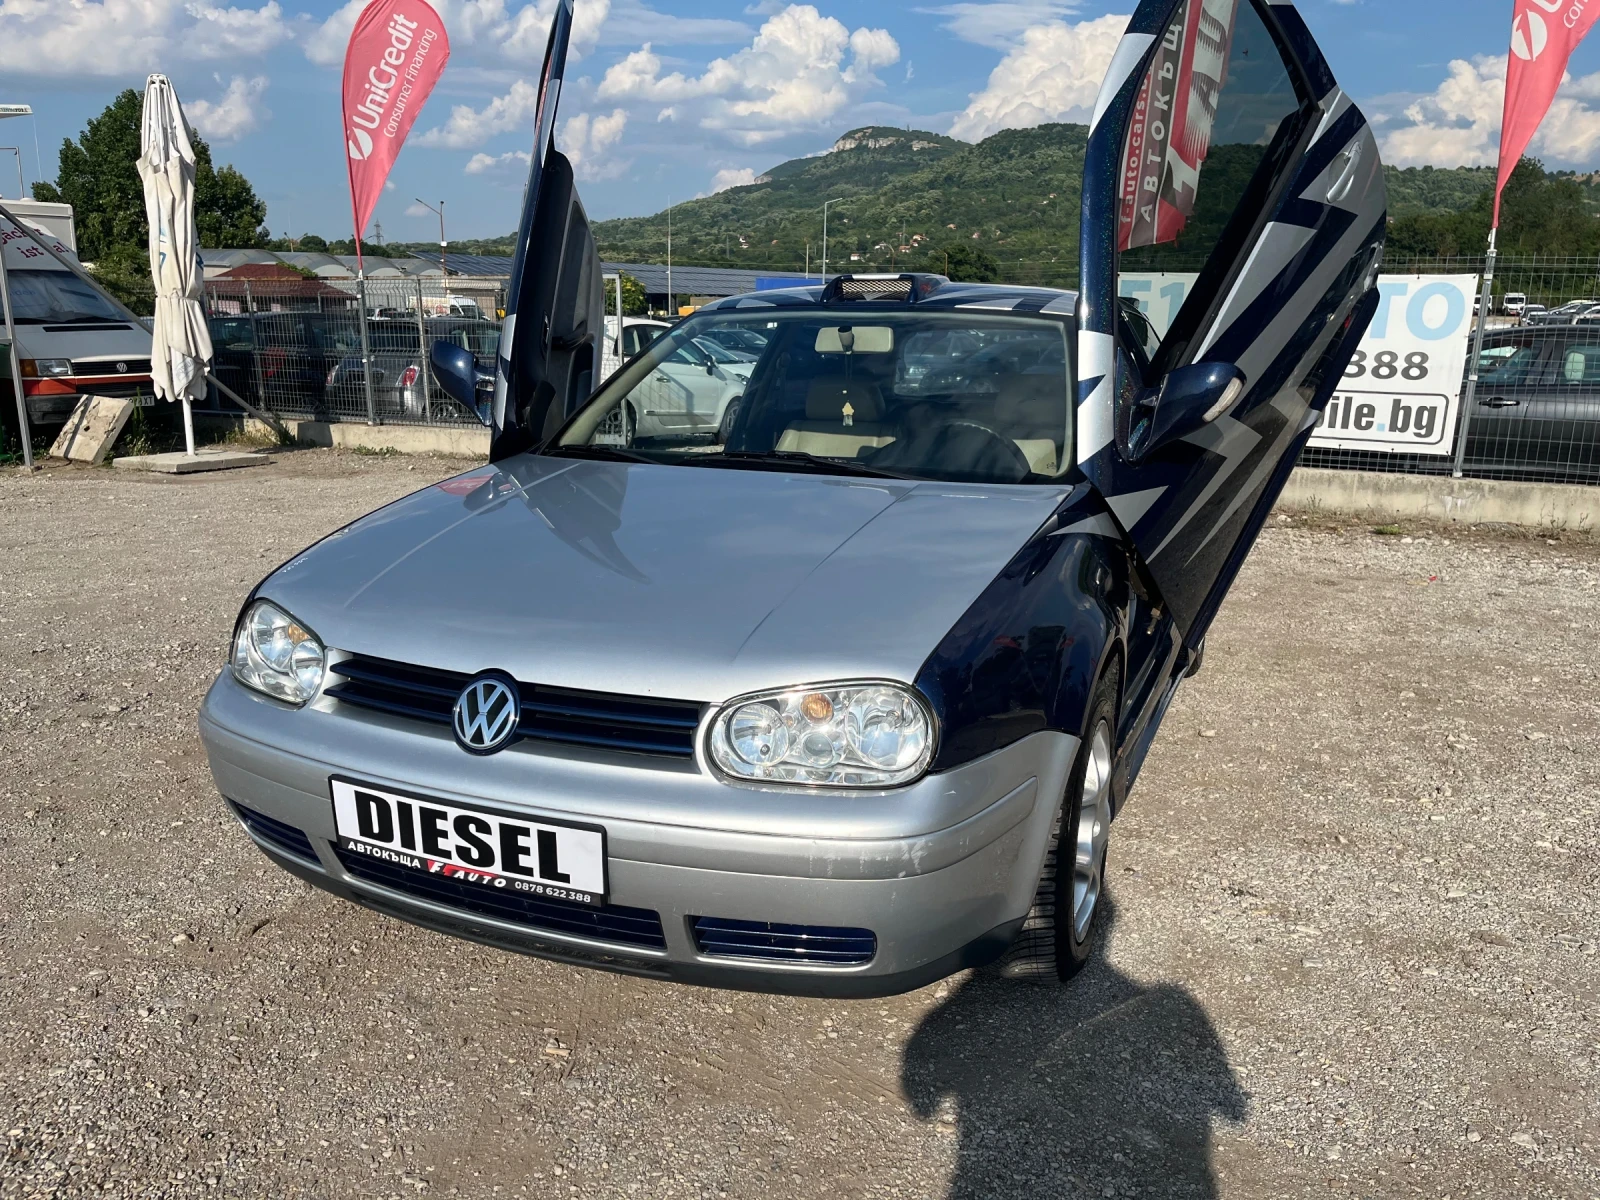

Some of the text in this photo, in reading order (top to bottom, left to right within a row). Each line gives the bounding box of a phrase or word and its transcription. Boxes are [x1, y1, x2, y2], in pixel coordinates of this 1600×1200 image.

[353, 13, 418, 129] UniCredit
[383, 28, 438, 138] Consumer Financing
[1141, 7, 1183, 223] АВТОКЪЩ
[16, 246, 44, 258] ist
[348, 841, 421, 868] АВТОКЪЩА
[515, 881, 543, 894] 0878
[546, 887, 567, 898] 622
[568, 891, 591, 903] 388
[354, 790, 570, 884] DIESEL
